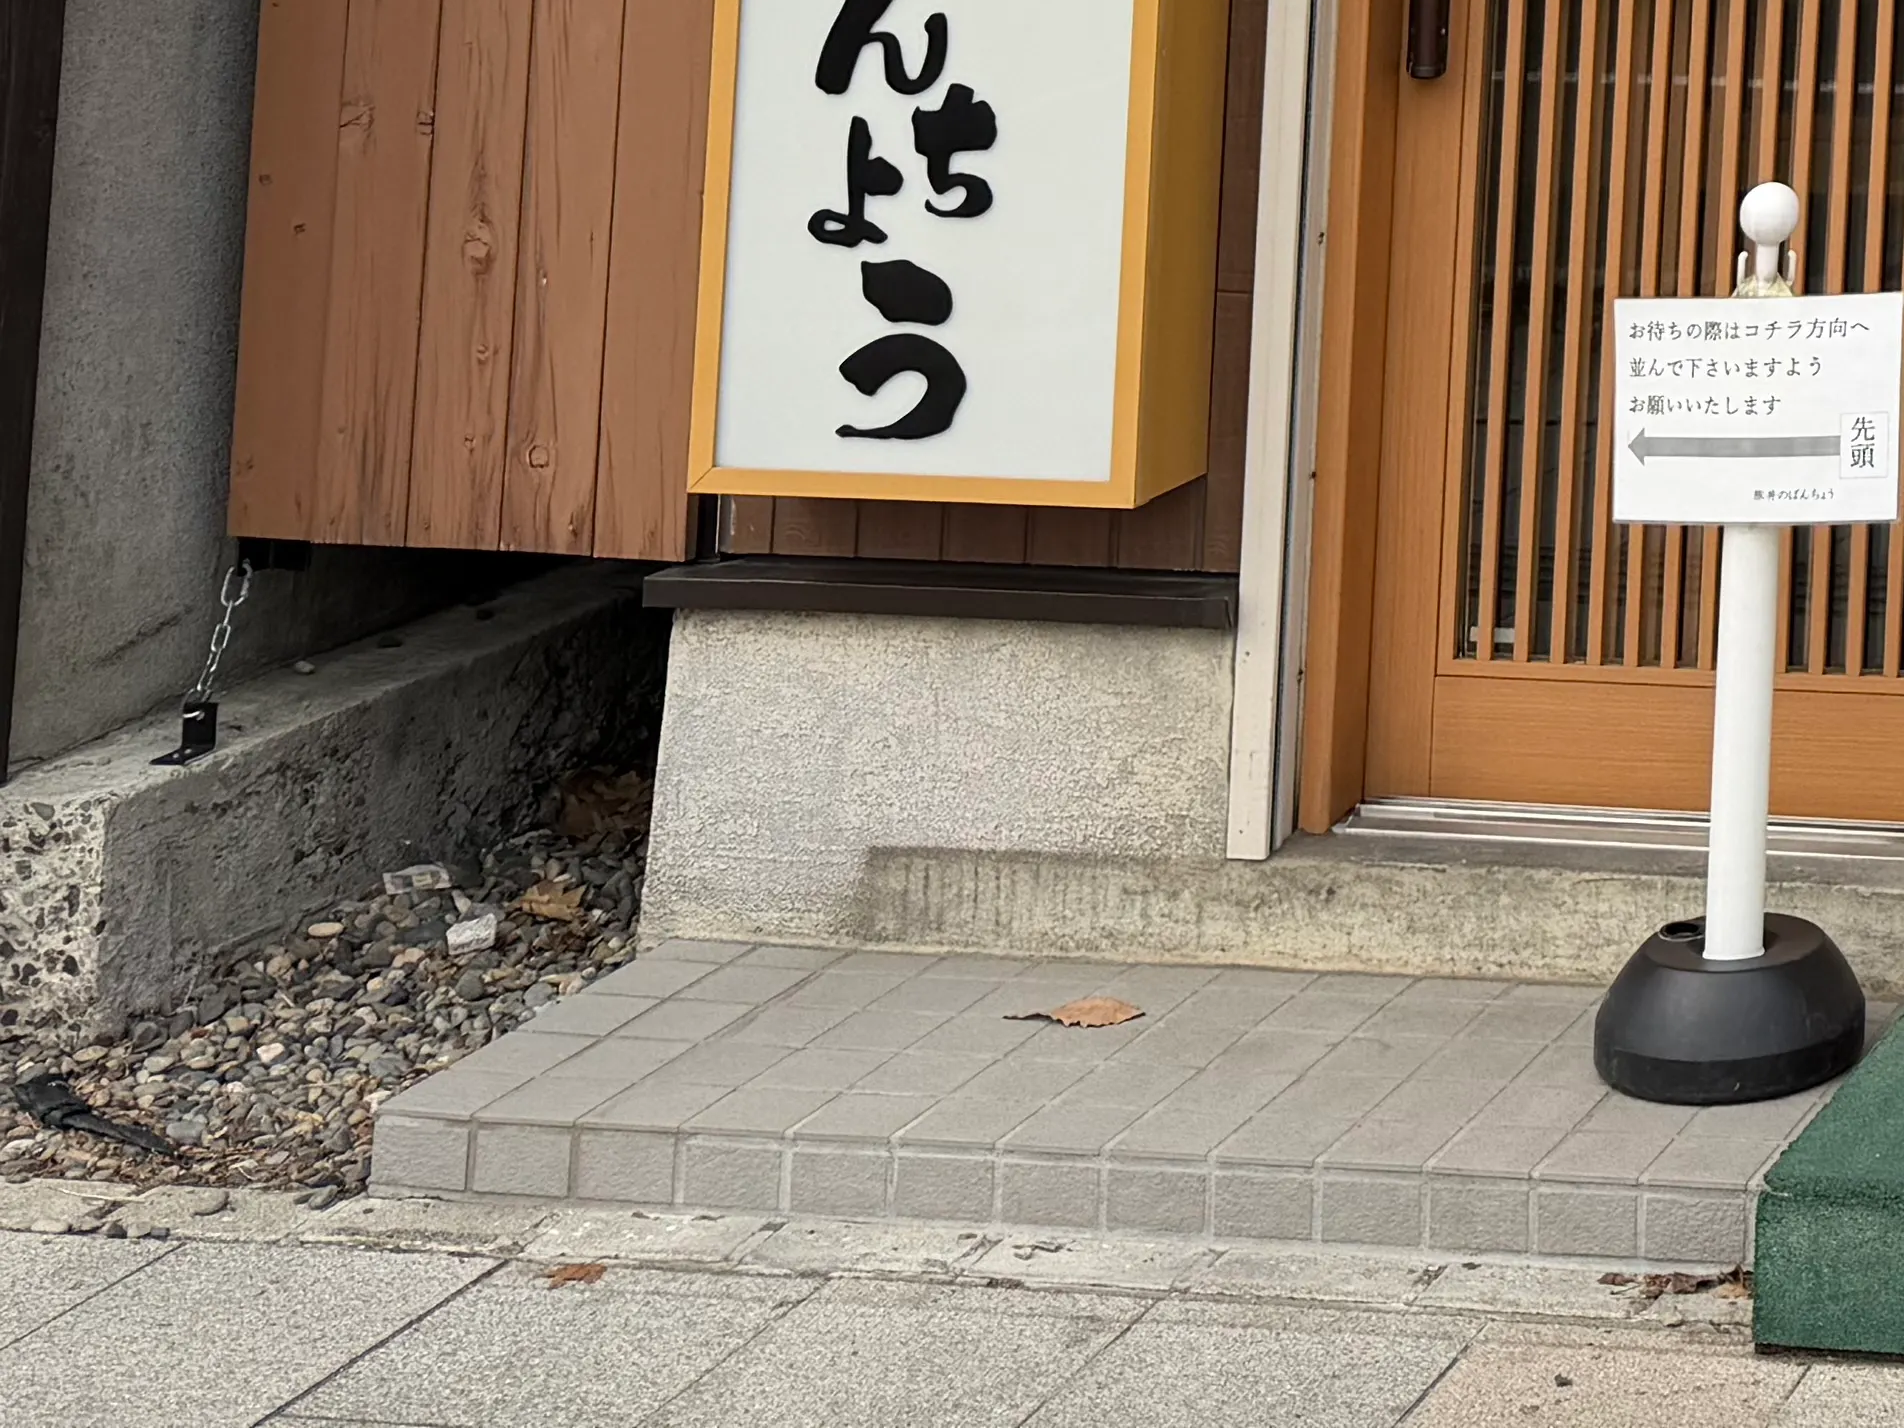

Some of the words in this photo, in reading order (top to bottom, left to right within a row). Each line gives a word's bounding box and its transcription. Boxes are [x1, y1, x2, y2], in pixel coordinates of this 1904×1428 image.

[1628, 317, 1870, 342] お待ちの際はコチラ方向へ
[1628, 356, 1822, 378] 並んで下さいますよう
[1628, 395, 1782, 416] お願いいたします
[1850, 416, 1876, 469] 先頭
